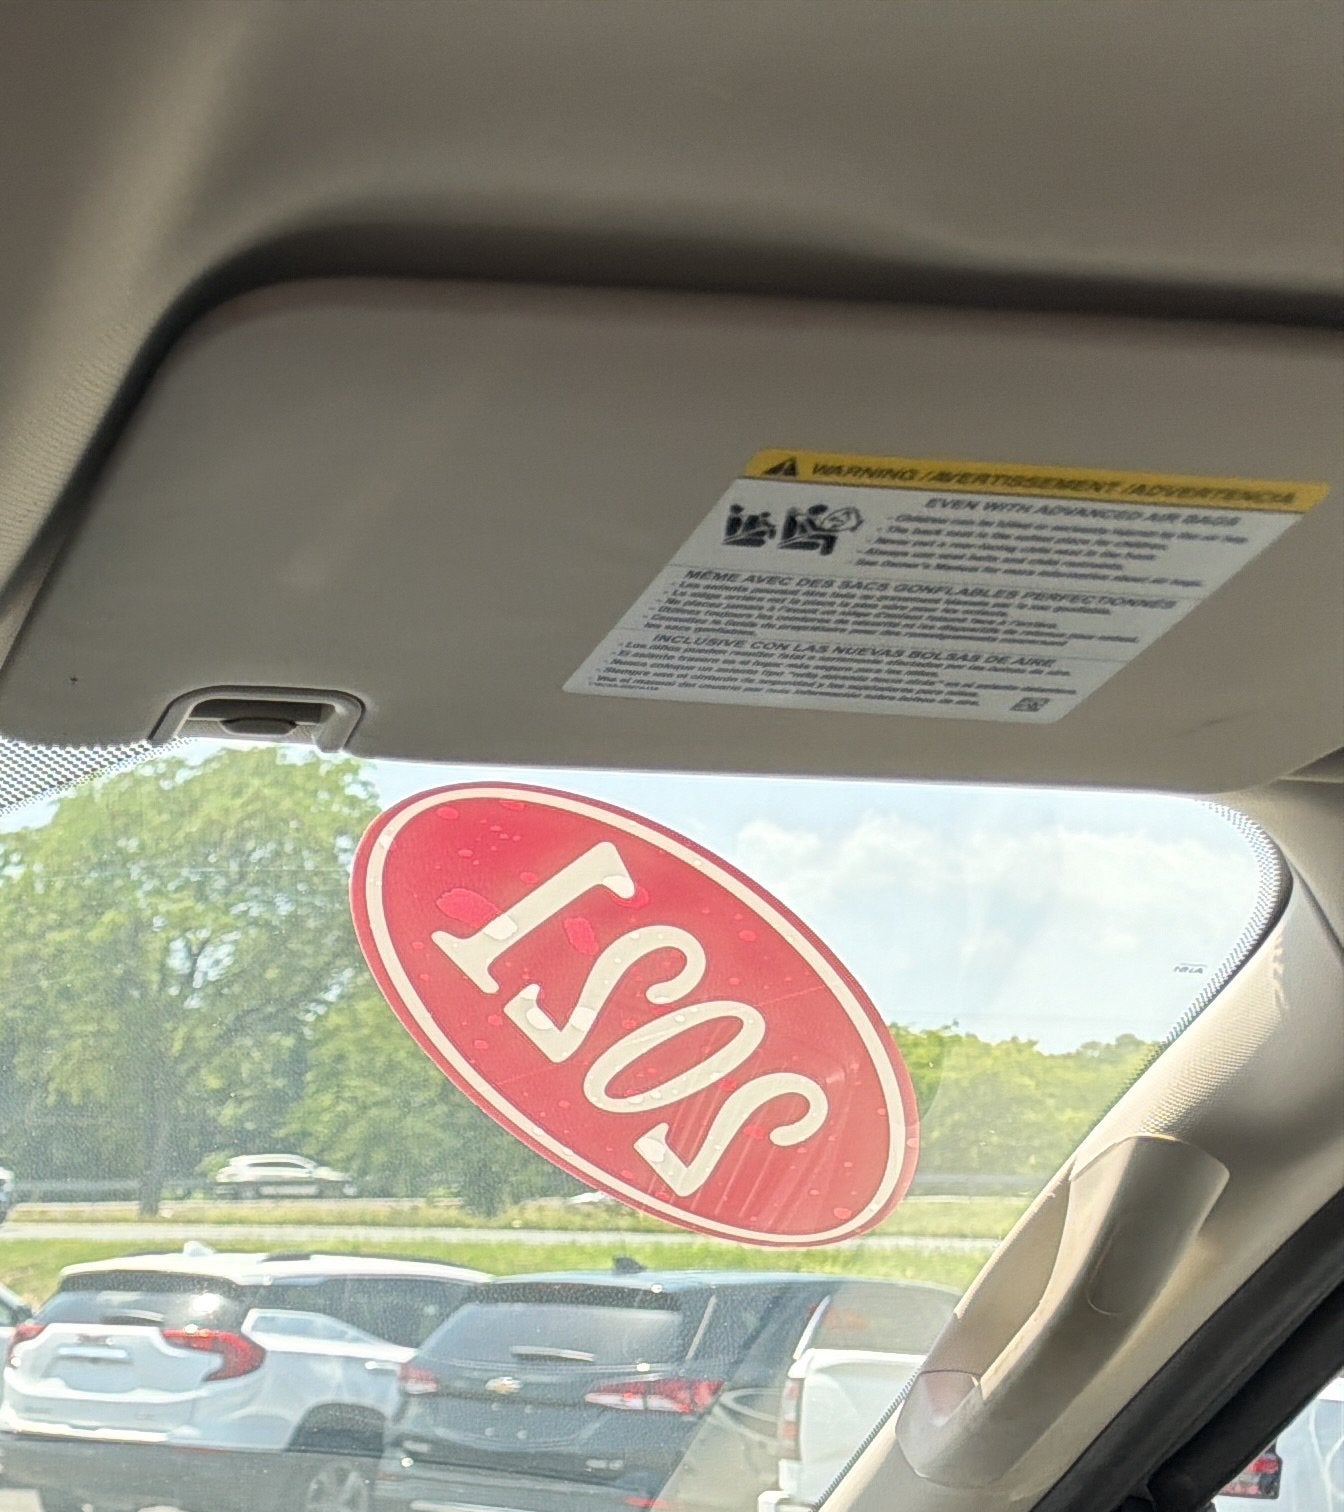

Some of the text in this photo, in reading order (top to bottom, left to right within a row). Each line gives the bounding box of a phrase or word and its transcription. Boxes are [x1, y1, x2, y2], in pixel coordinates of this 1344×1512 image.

[812, 462, 918, 480] WARNING
[924, 498, 1242, 526] EVEN WITH ADVANCED AIR BAGS
[742, 574, 792, 587] AVEC
[795, 577, 833, 589] DES
[837, 580, 890, 592] SACS
[652, 633, 746, 649] INCLUSIVE
[749, 640, 789, 652] CON
[792, 643, 832, 654] LAS
[835, 645, 904, 659] NUEVAS
[907, 649, 981, 663] BOLSAS
[1012, 656, 1057, 668] AIRE
